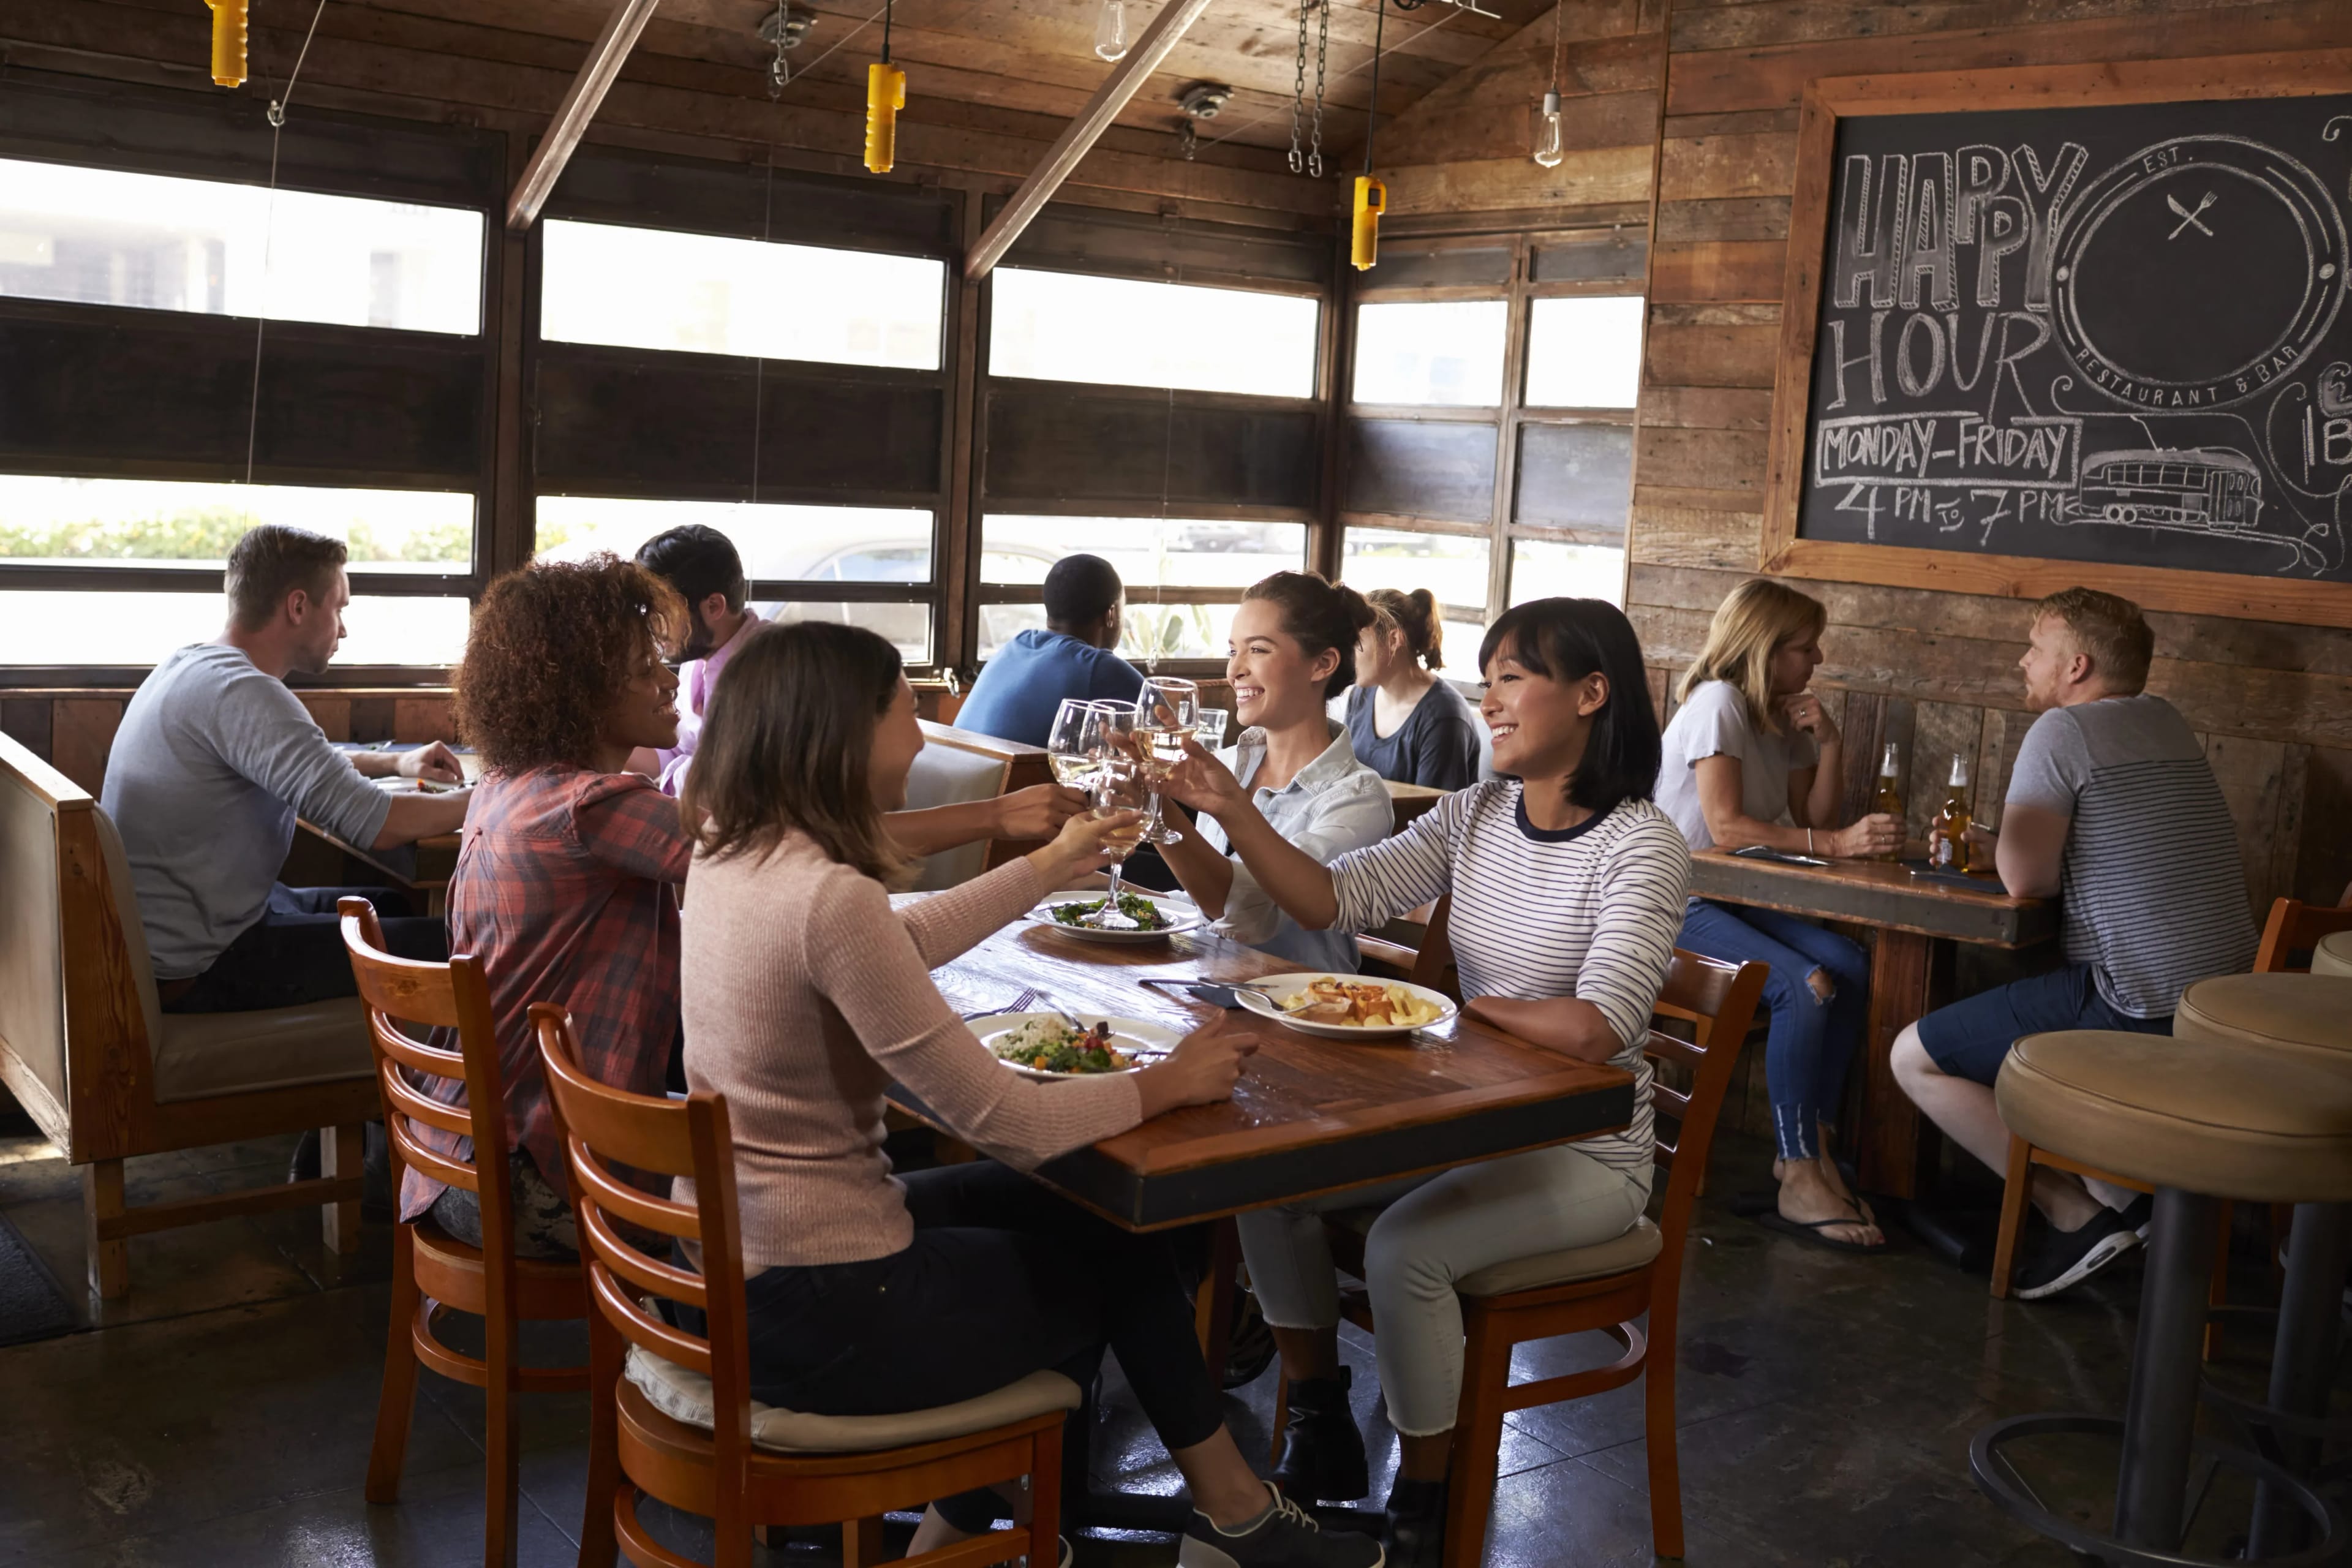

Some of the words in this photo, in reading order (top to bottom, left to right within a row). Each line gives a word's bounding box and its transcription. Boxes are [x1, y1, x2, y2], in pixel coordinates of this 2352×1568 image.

[1834, 141, 2089, 311] HAPPY
[1826, 310, 2052, 424] HOUR
[2075, 347, 2218, 407] RESTAURANT
[2236, 376, 2250, 393] &
[2255, 345, 2299, 383] BAR
[1937, 510, 1959, 523] TO
